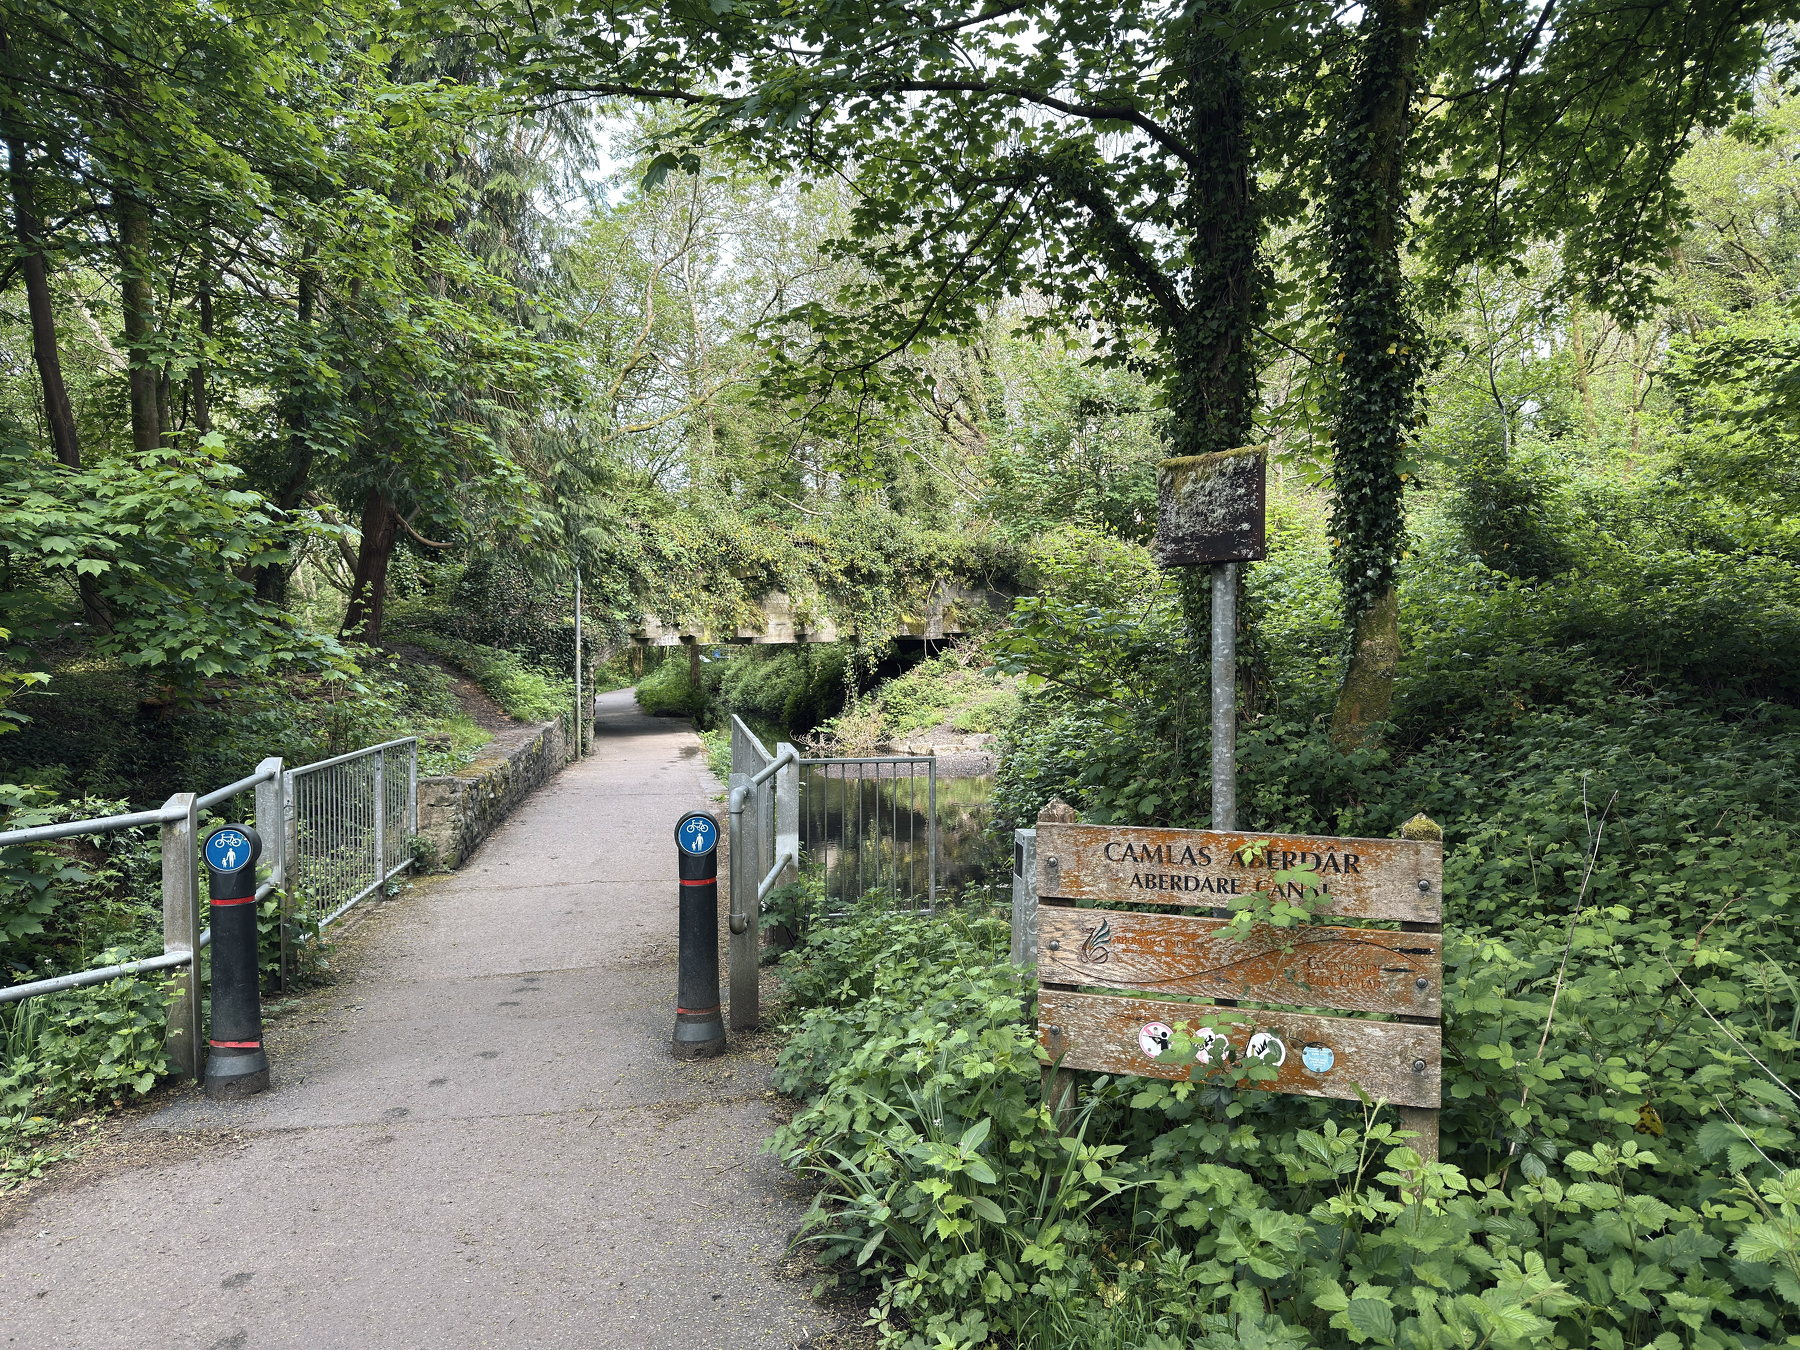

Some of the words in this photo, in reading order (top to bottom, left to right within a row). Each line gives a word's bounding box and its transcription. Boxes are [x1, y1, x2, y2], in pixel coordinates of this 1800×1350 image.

[1104, 842, 1212, 867] CAMLAS
[1228, 846, 1360, 874] ABERDÂR
[1129, 873, 1242, 895] ABERDARE
